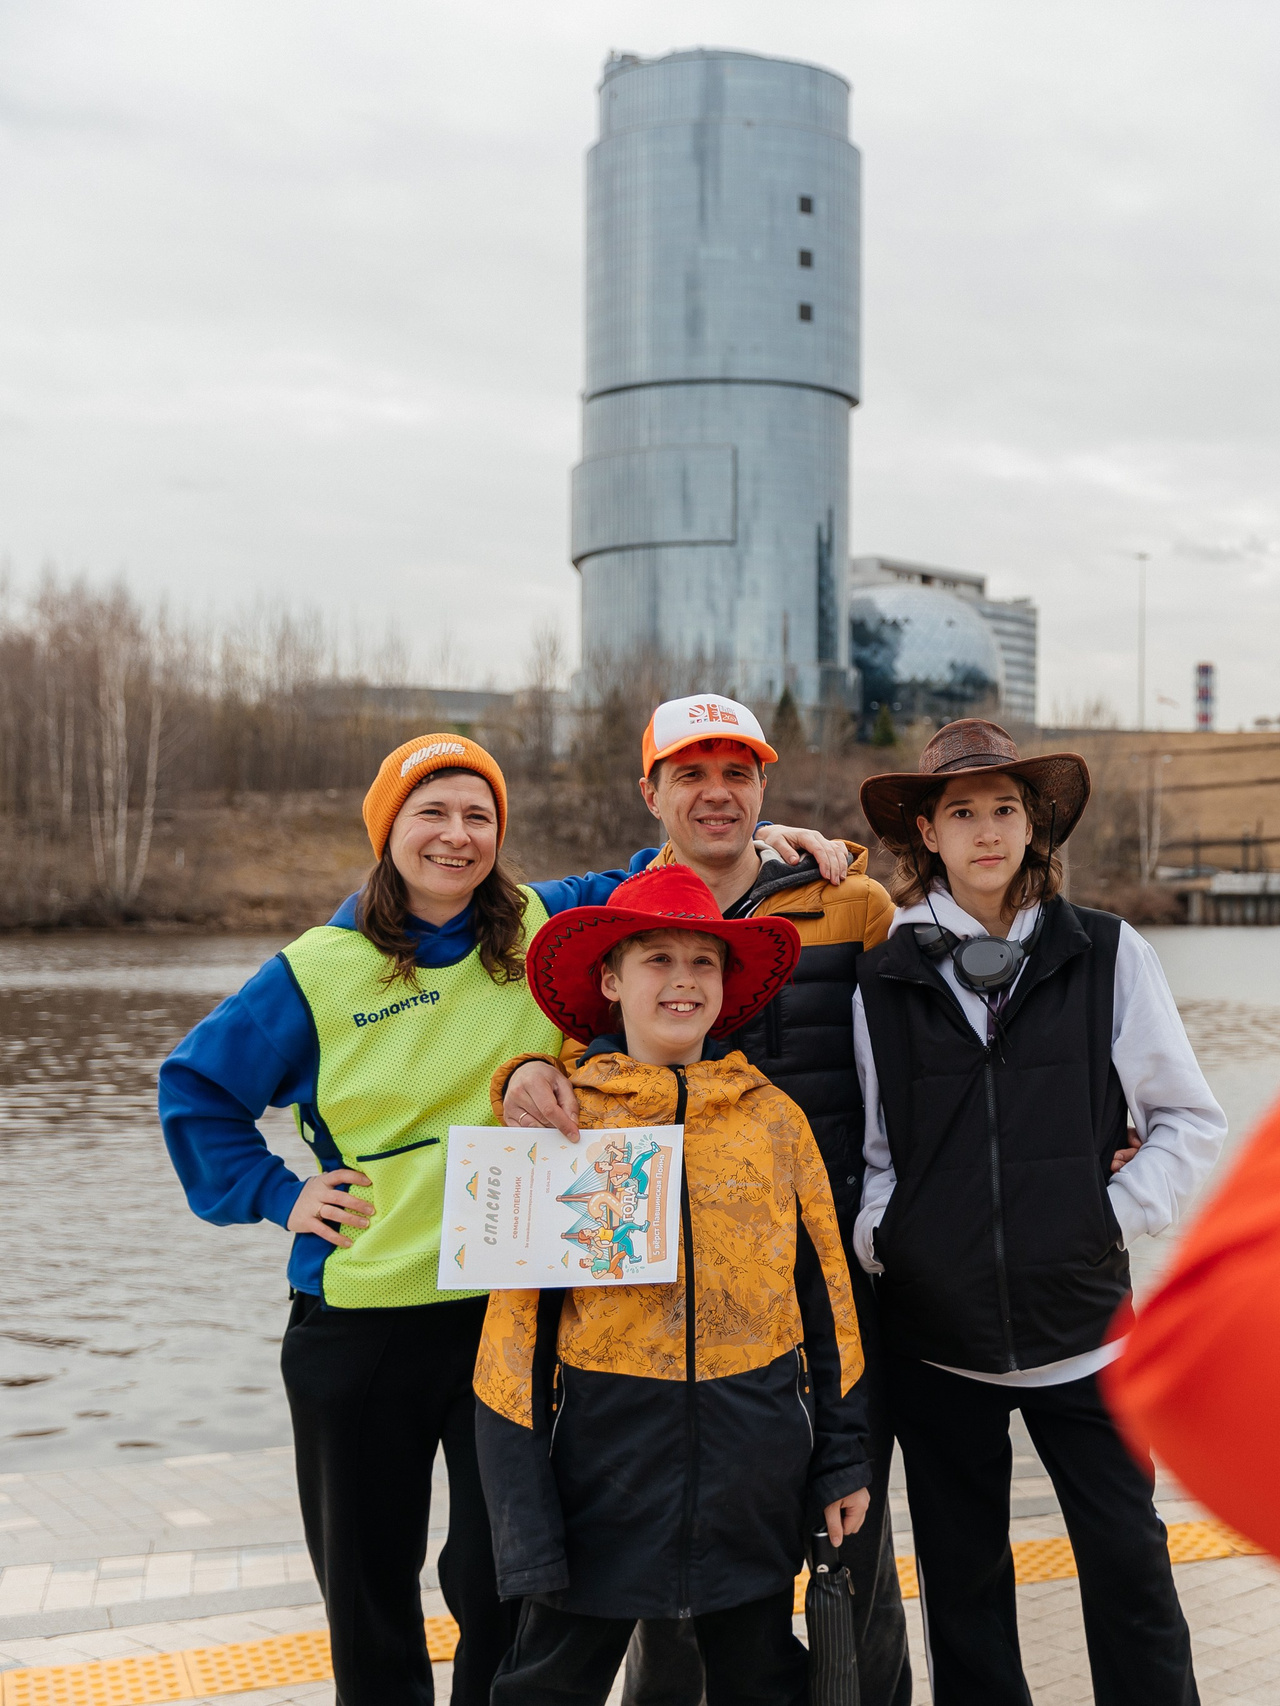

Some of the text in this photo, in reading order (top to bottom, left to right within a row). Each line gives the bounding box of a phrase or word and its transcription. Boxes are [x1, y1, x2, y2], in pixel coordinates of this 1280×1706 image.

[353, 989, 440, 1028] Волонтёр
[655, 1154, 665, 1179] Пойма
[483, 1165, 503, 1246] СПАСИБО
[512, 1176, 523, 1240] семье ОЛЕЙНИК
[587, 1190, 624, 1219] 2
[622, 1185, 636, 1222] ГОДА
[653, 1179, 662, 1227] Павшинская
[653, 1228, 661, 1249] вёрст
